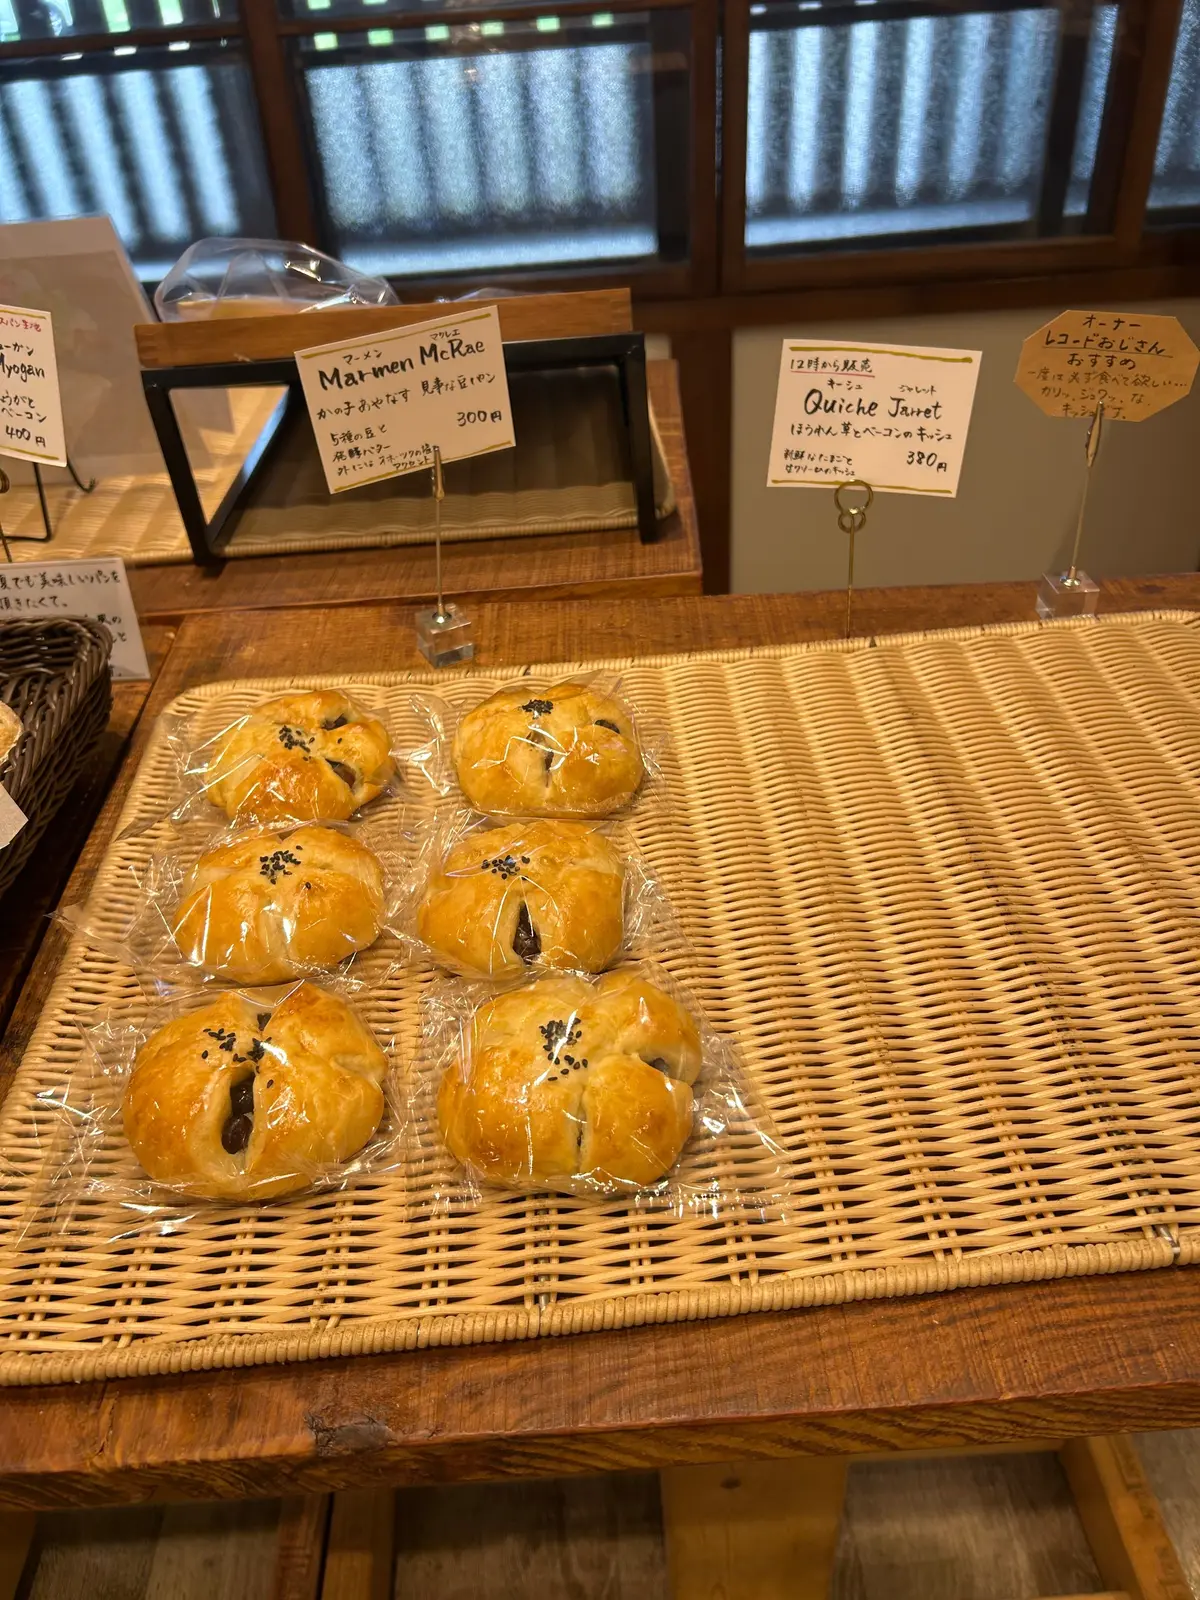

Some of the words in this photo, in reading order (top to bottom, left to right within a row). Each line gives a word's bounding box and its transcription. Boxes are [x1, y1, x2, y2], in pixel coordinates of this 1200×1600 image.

[1083, 314, 1141, 331] オーナー
[1045, 329, 1166, 355] レコードおじさん
[318, 358, 414, 391] Marmen
[419, 339, 485, 365] McRae
[343, 349, 382, 365] マーメン
[790, 357, 873, 373] 12時から販売
[1067, 353, 1136, 370] おすすめ
[827, 378, 863, 390] キーシュ
[804, 388, 879, 416] Quiche
[888, 396, 942, 420] Jarret
[1, 407, 47, 423] ベーコン
[456, 410, 502, 427] 300円
[5, 424, 46, 447] 400円
[393, 456, 430, 470] アクセント
[907, 451, 948, 473] 380円
